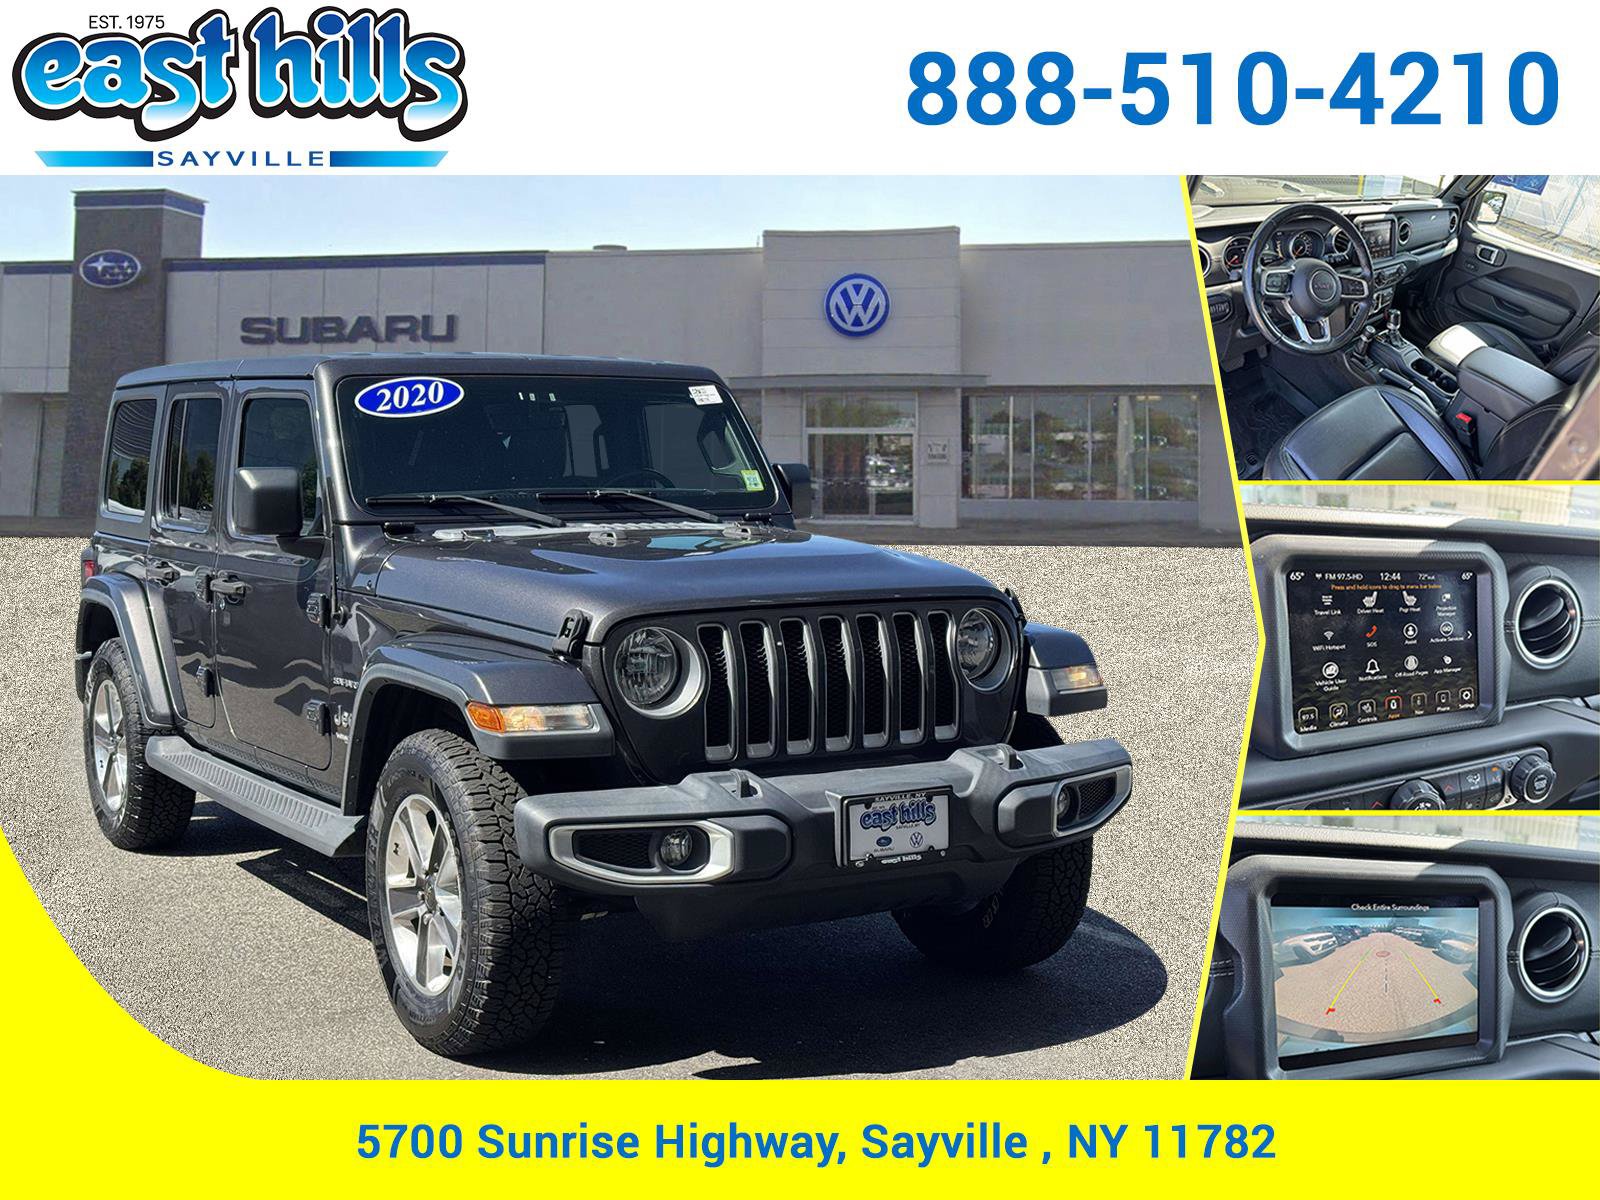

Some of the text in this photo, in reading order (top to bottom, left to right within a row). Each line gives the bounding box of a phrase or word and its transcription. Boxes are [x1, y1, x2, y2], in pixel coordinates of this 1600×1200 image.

[240, 315, 458, 345] SUBARU
[1380, 572, 1401, 580] 12:44
[860, 799, 937, 832] east hills
[1351, 903, 1430, 912] Check Entire Surroundings
